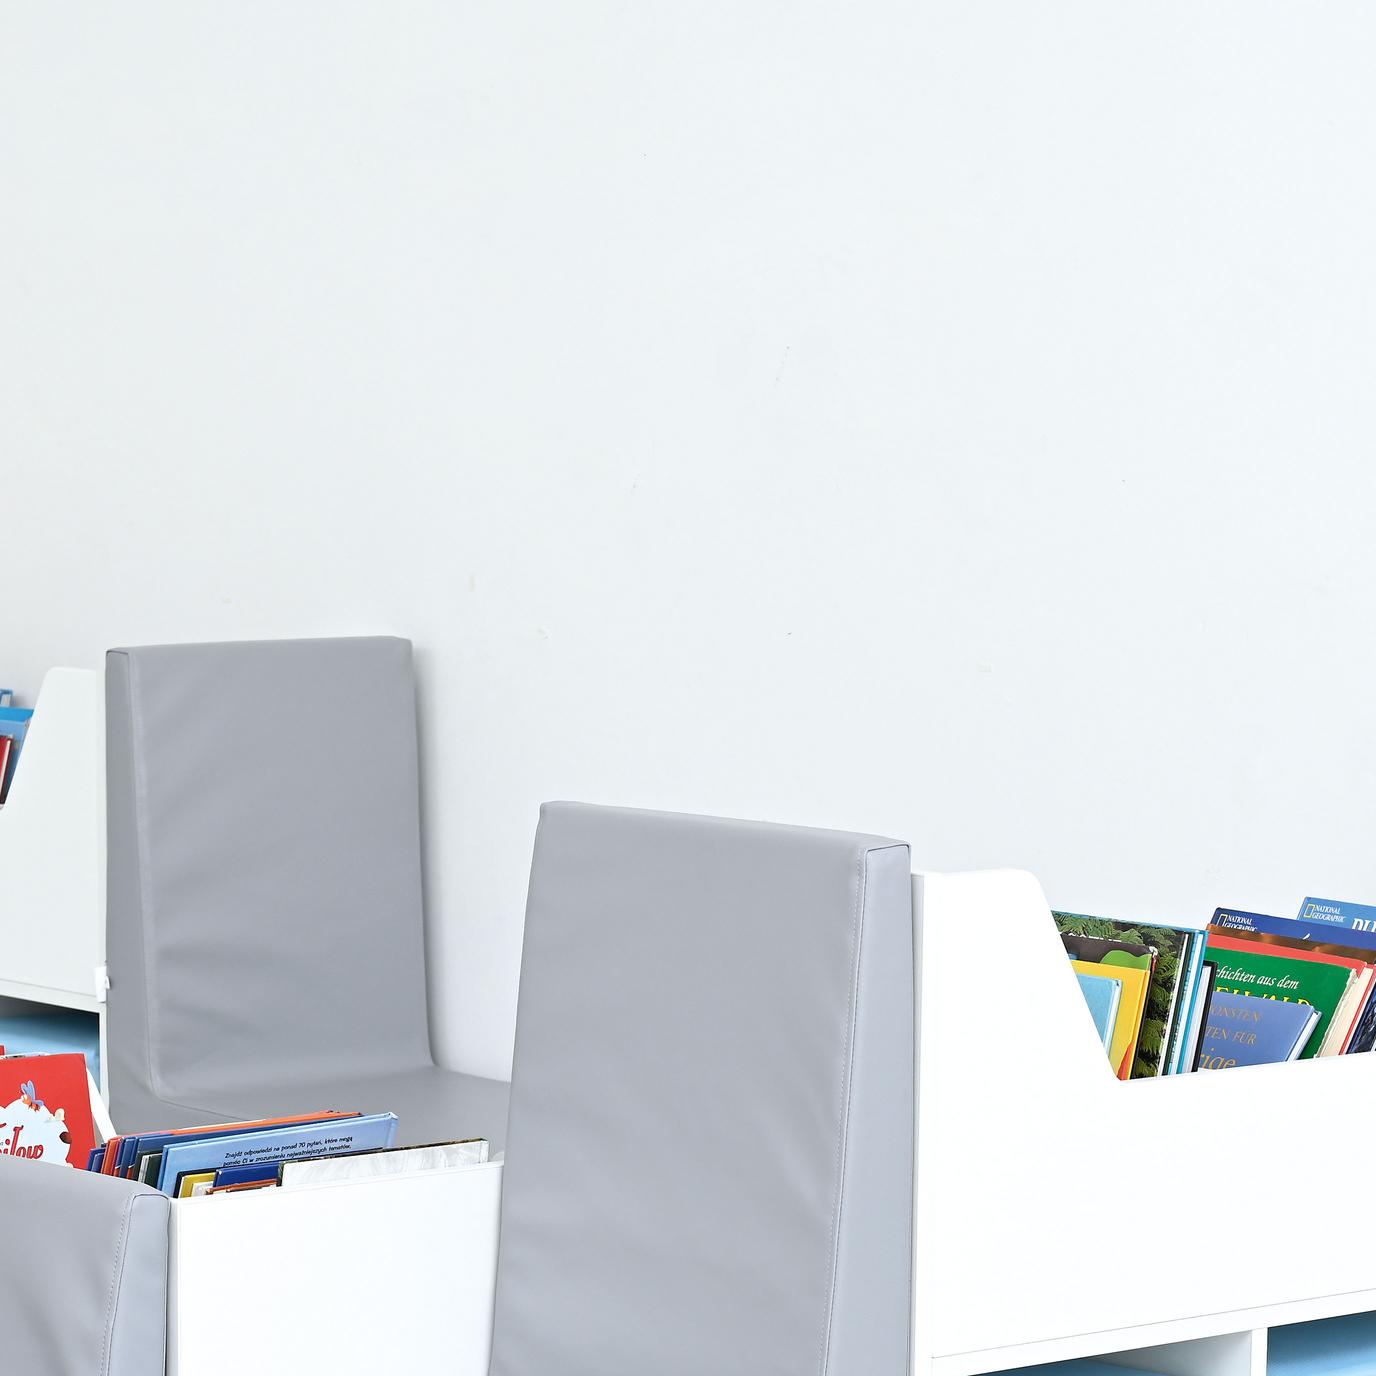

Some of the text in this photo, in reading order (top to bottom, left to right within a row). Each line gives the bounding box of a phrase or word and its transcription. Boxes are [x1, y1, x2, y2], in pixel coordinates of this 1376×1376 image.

[1314, 904, 1341, 914] NATIONAL
[1227, 914, 1253, 925] NATIONAL
[1312, 912, 1346, 923] GEOGRAPHIC
[1224, 923, 1258, 932] GEOGRAPHIC
[1256, 976, 1275, 987] aus
[1277, 975, 1300, 990] dem
[244, 1147, 272, 1156] odpowiedzi
[281, 1143, 298, 1152] ponad
[255, 1154, 285, 1162] zrozumieniu
[286, 1147, 328, 1160] najważniejszych
